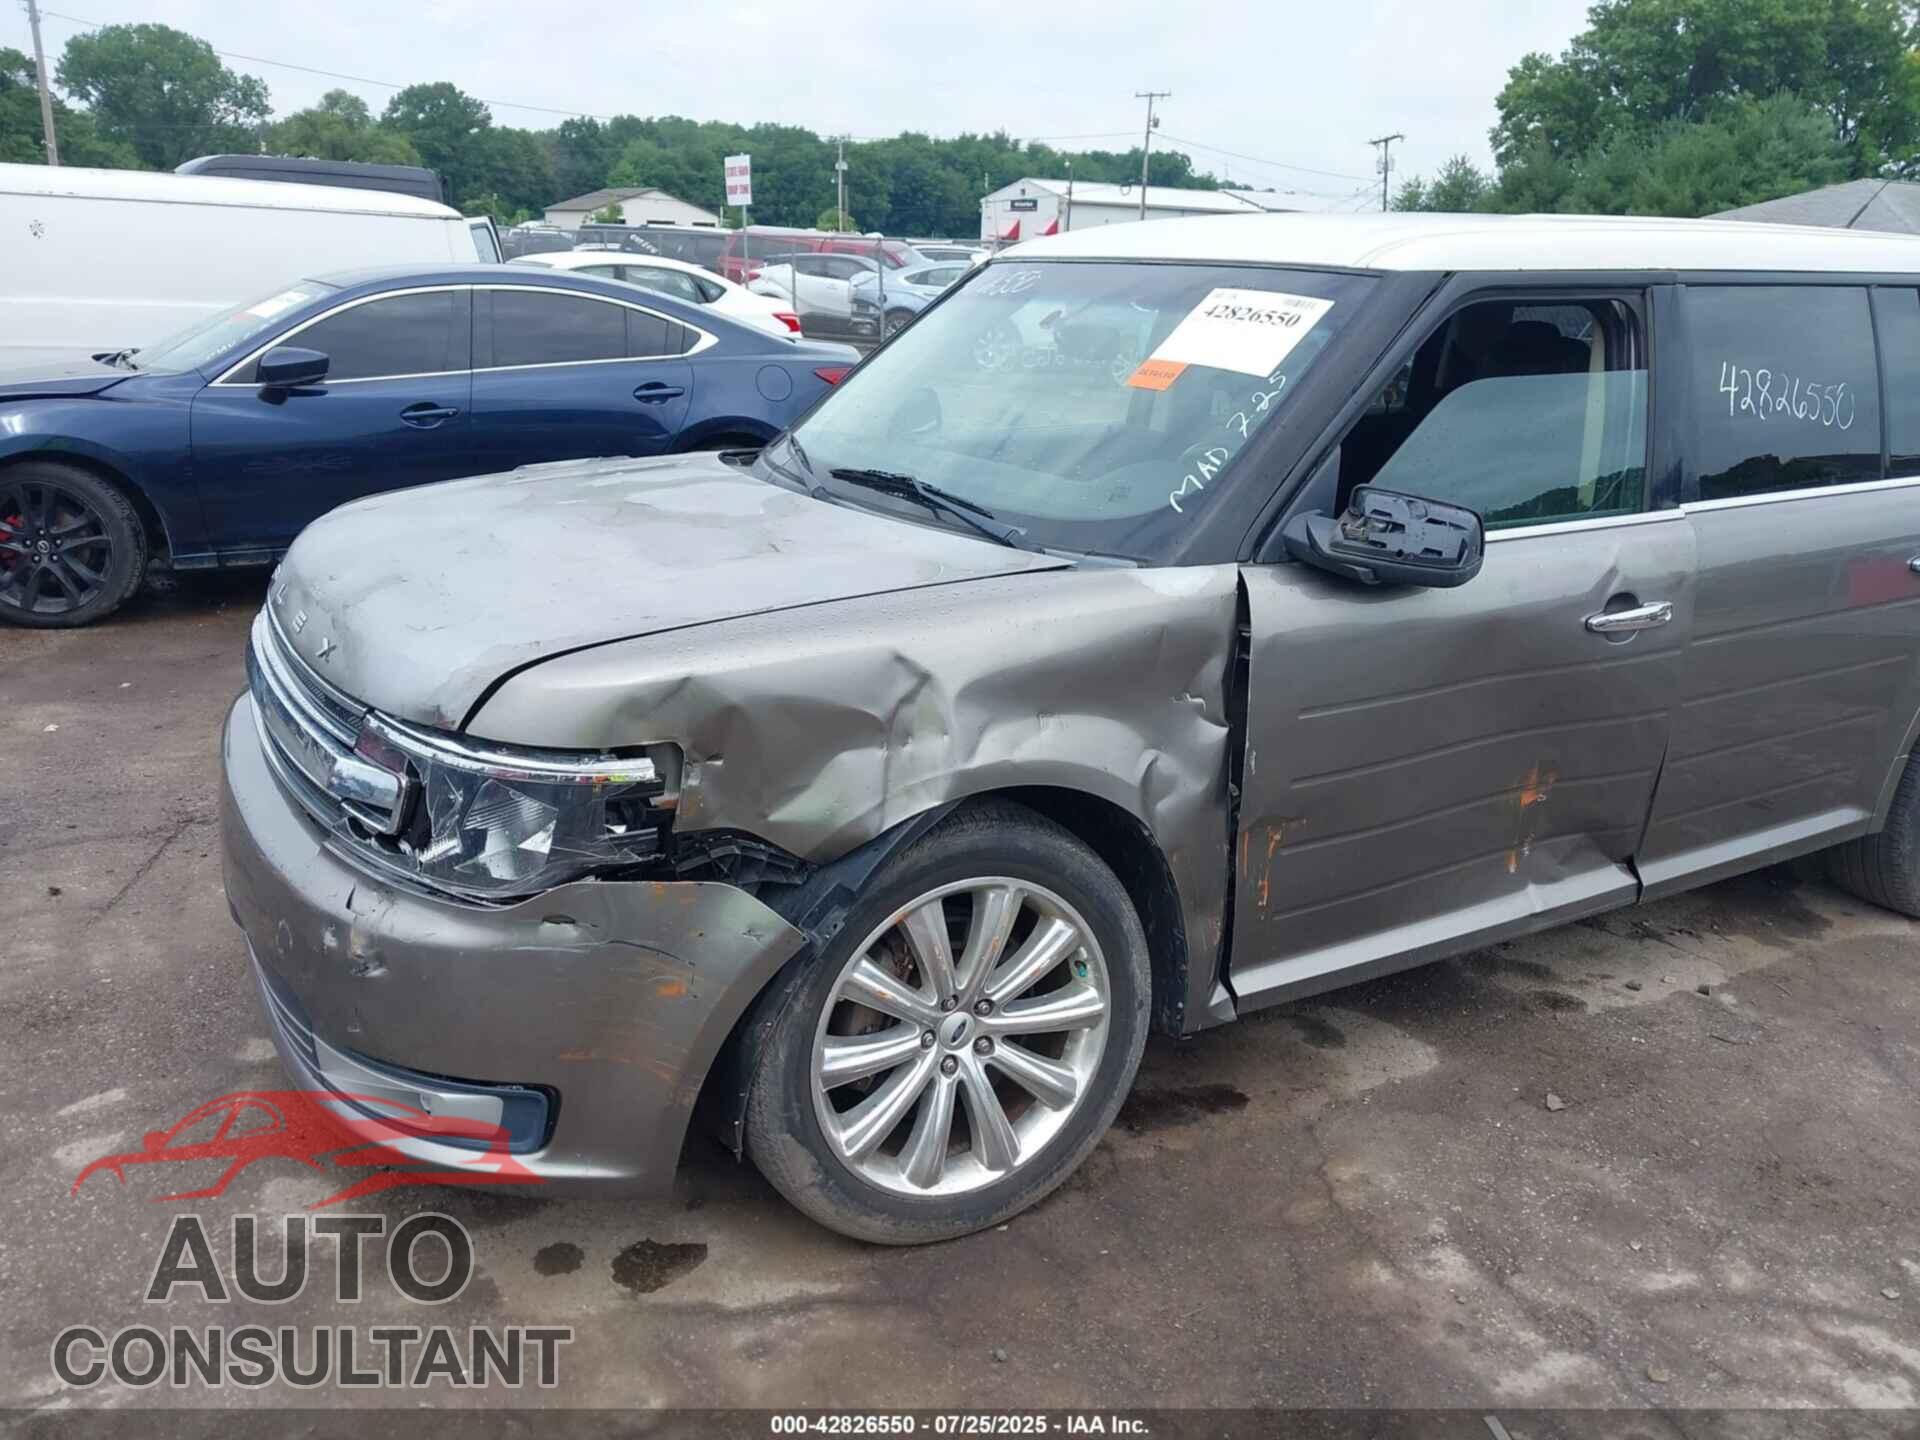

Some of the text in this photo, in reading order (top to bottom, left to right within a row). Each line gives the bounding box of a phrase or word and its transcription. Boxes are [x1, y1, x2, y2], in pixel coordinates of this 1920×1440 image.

[1203, 303, 1302, 328] 42826550
[1719, 361, 1855, 430] 42826550
[1169, 447, 1228, 513] MAD
